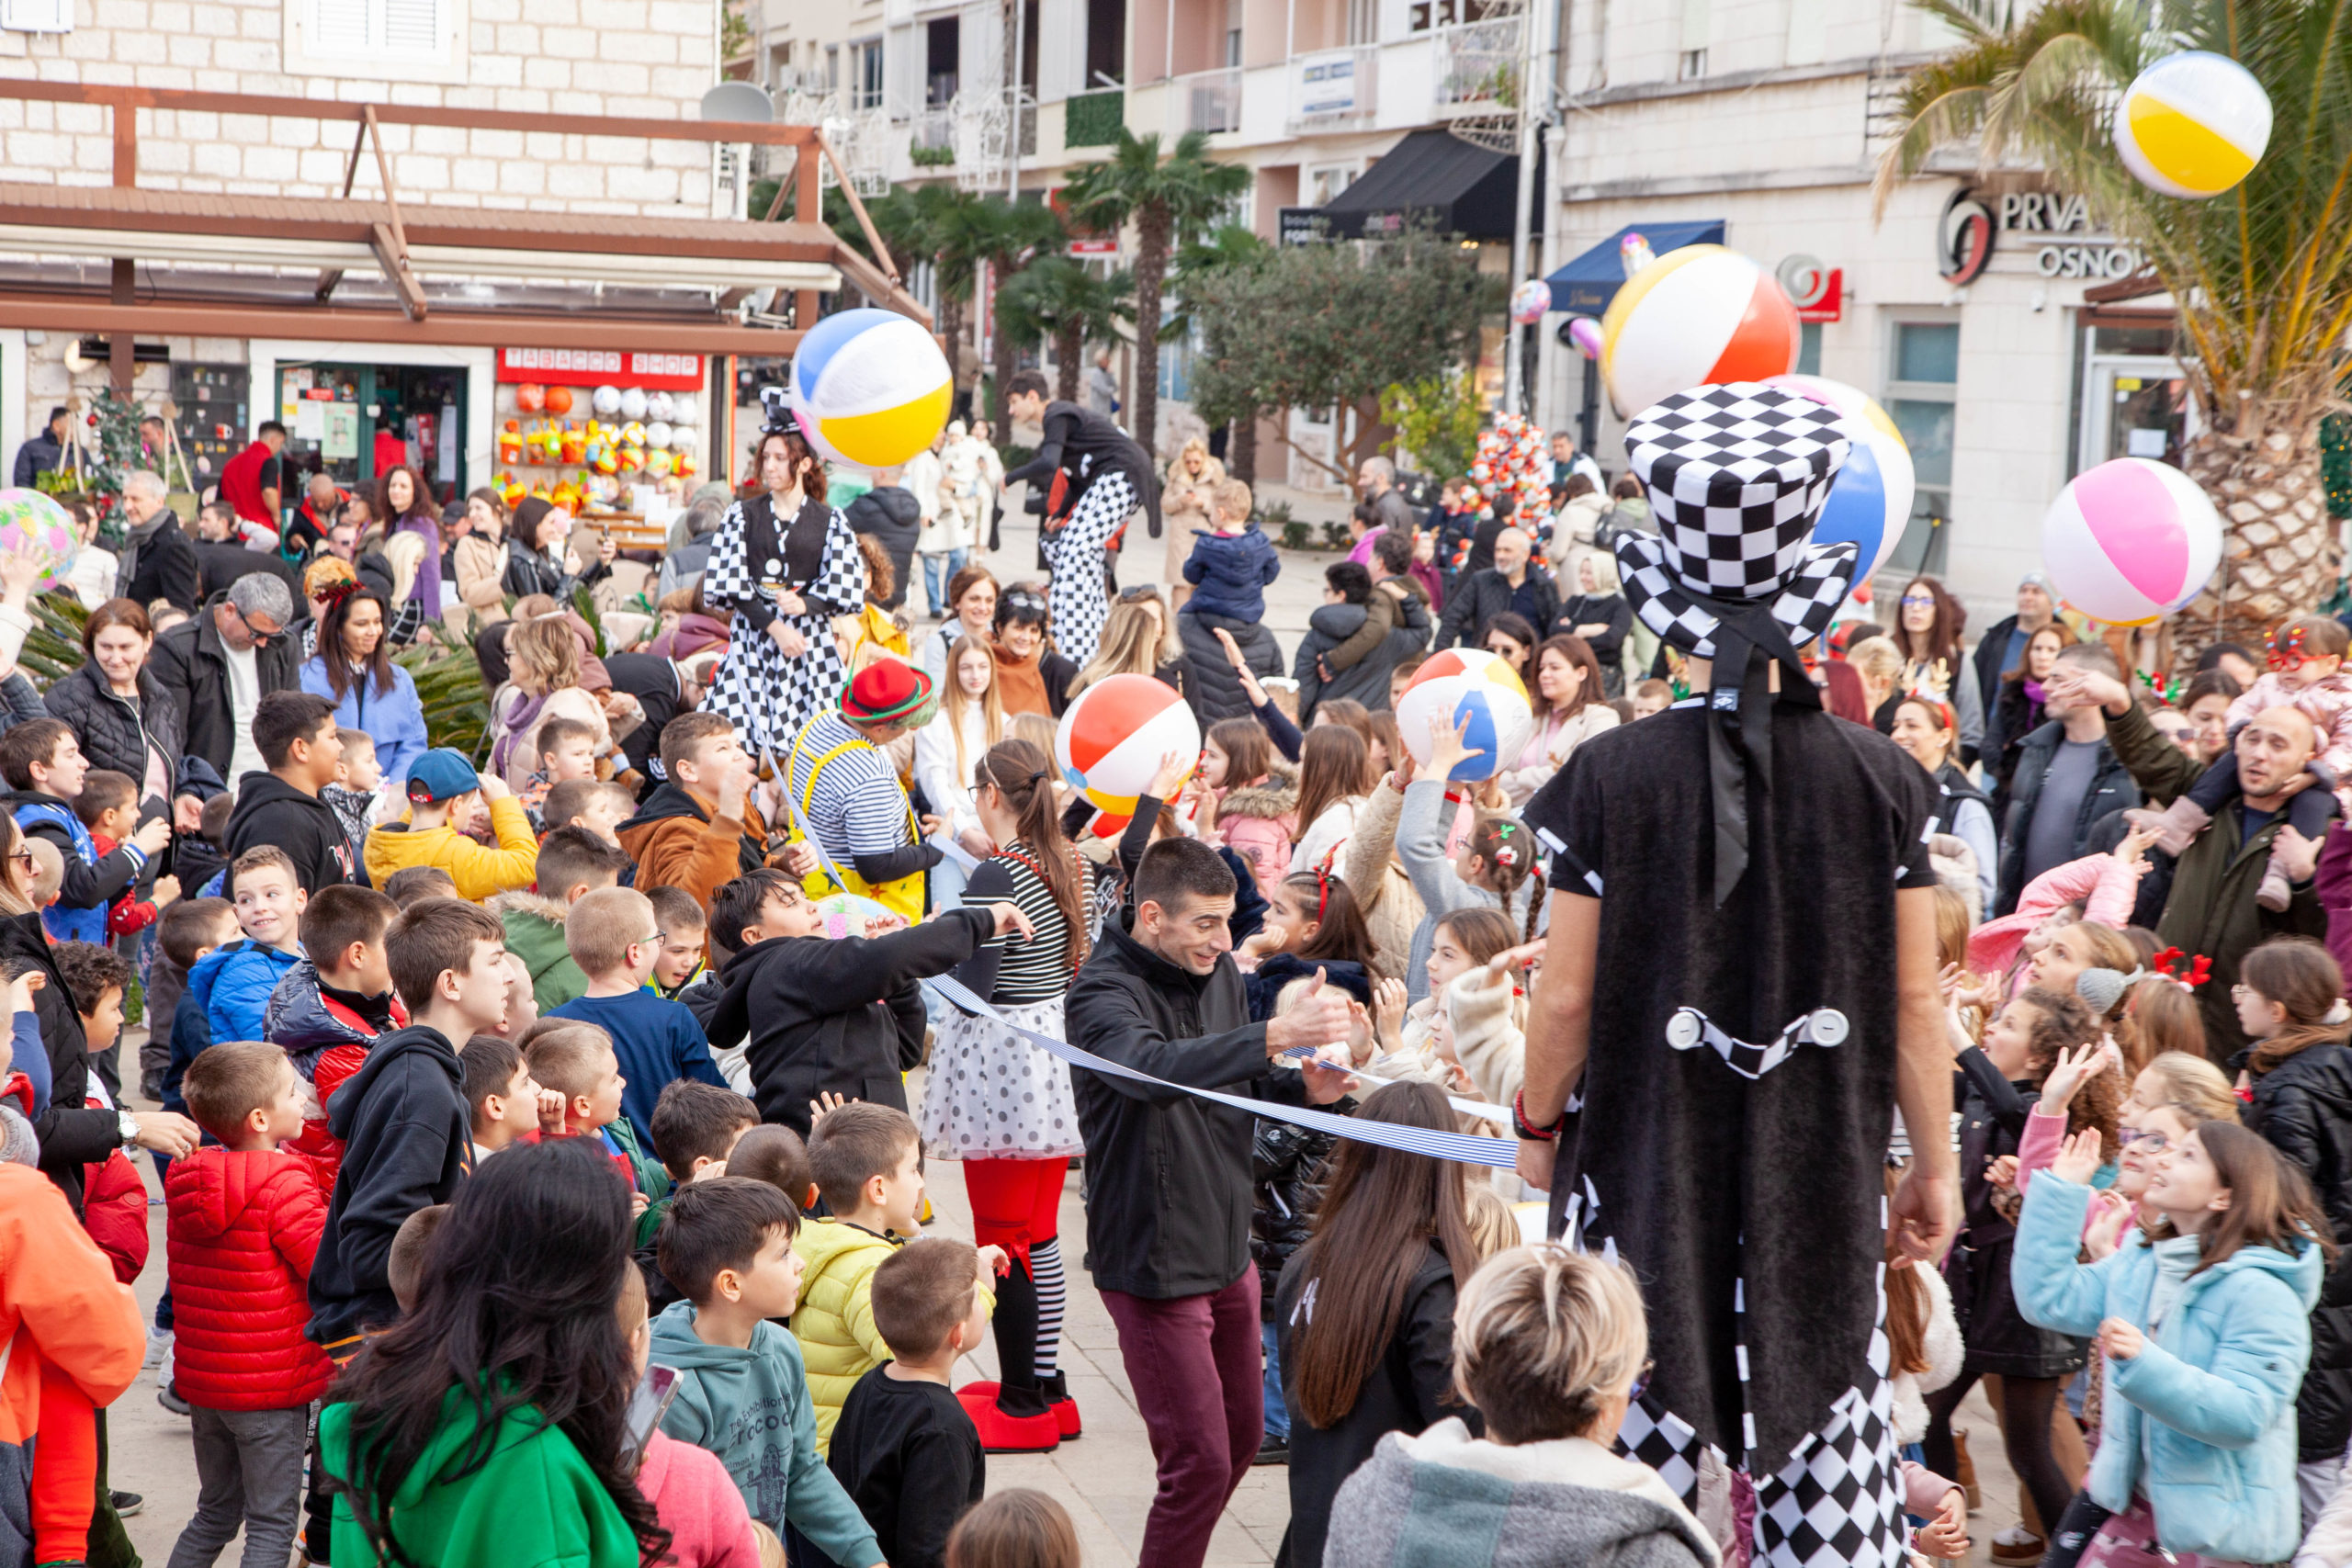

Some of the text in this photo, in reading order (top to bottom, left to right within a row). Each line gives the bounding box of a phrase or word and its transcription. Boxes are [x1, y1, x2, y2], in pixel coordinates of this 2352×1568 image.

[1999, 192, 2093, 231] PRVA
[509, 348, 696, 375] TABACCO SHOP
[742, 1395, 785, 1422] Exhibition
